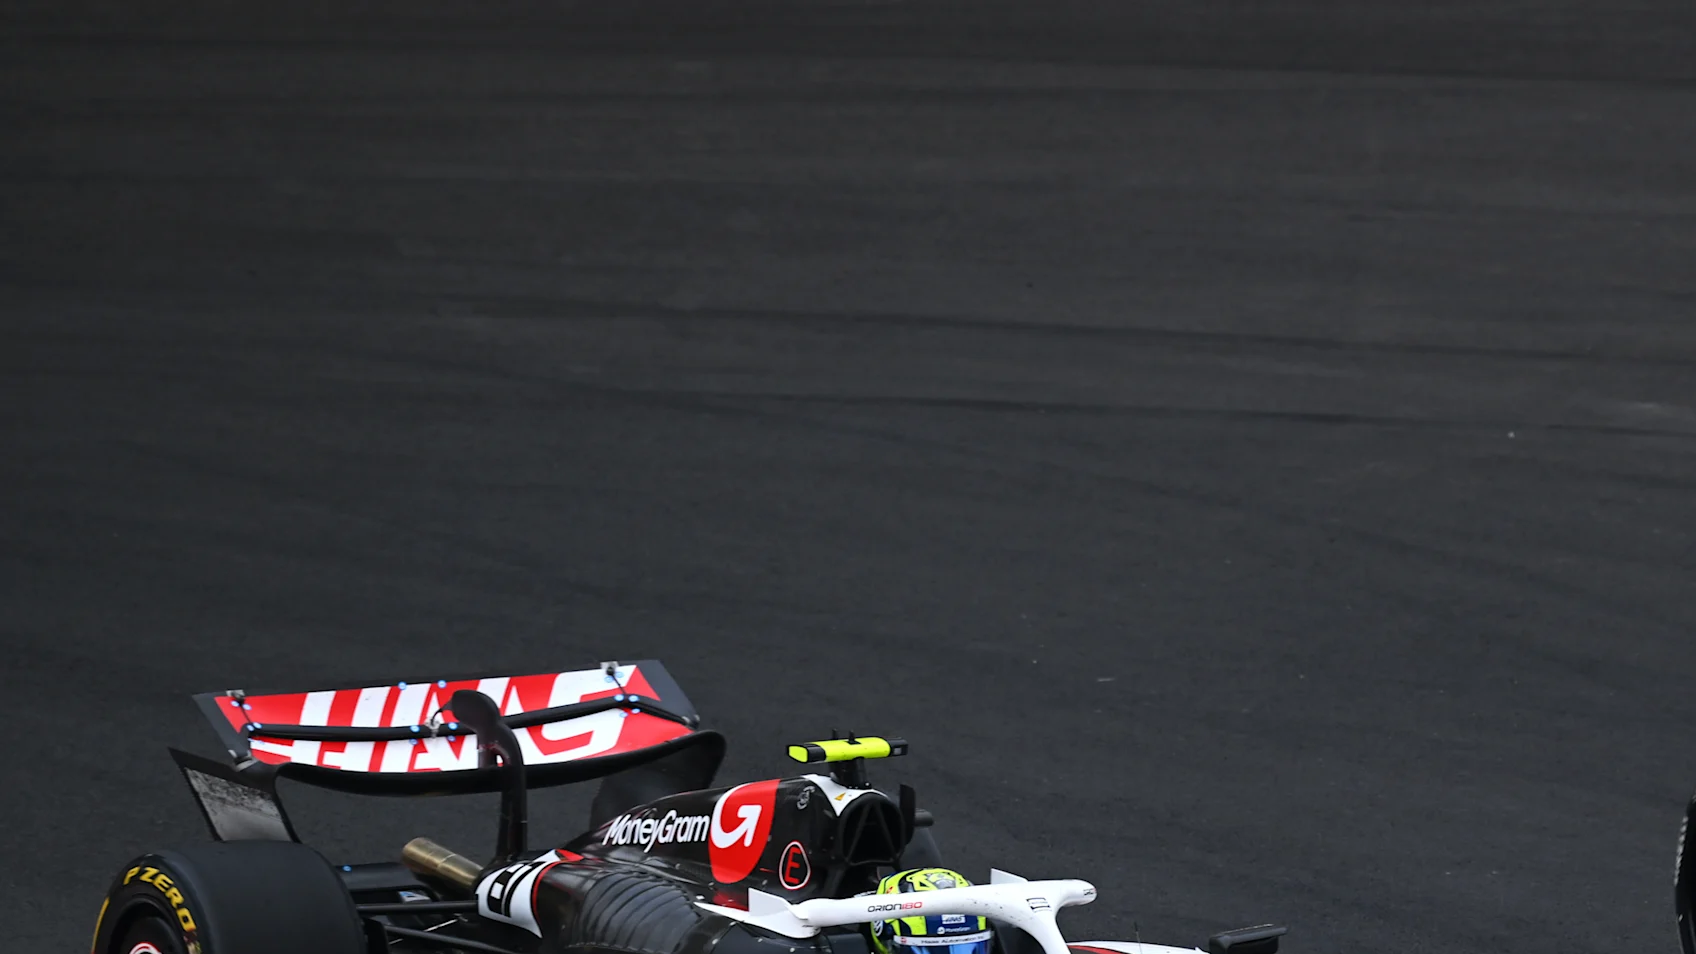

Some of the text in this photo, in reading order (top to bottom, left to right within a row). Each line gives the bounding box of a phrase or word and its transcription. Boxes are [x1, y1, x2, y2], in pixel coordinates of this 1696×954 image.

[602, 809, 711, 853] MoneyGram
[123, 866, 197, 932] P ZERO
[867, 901, 923, 912] ORION180
